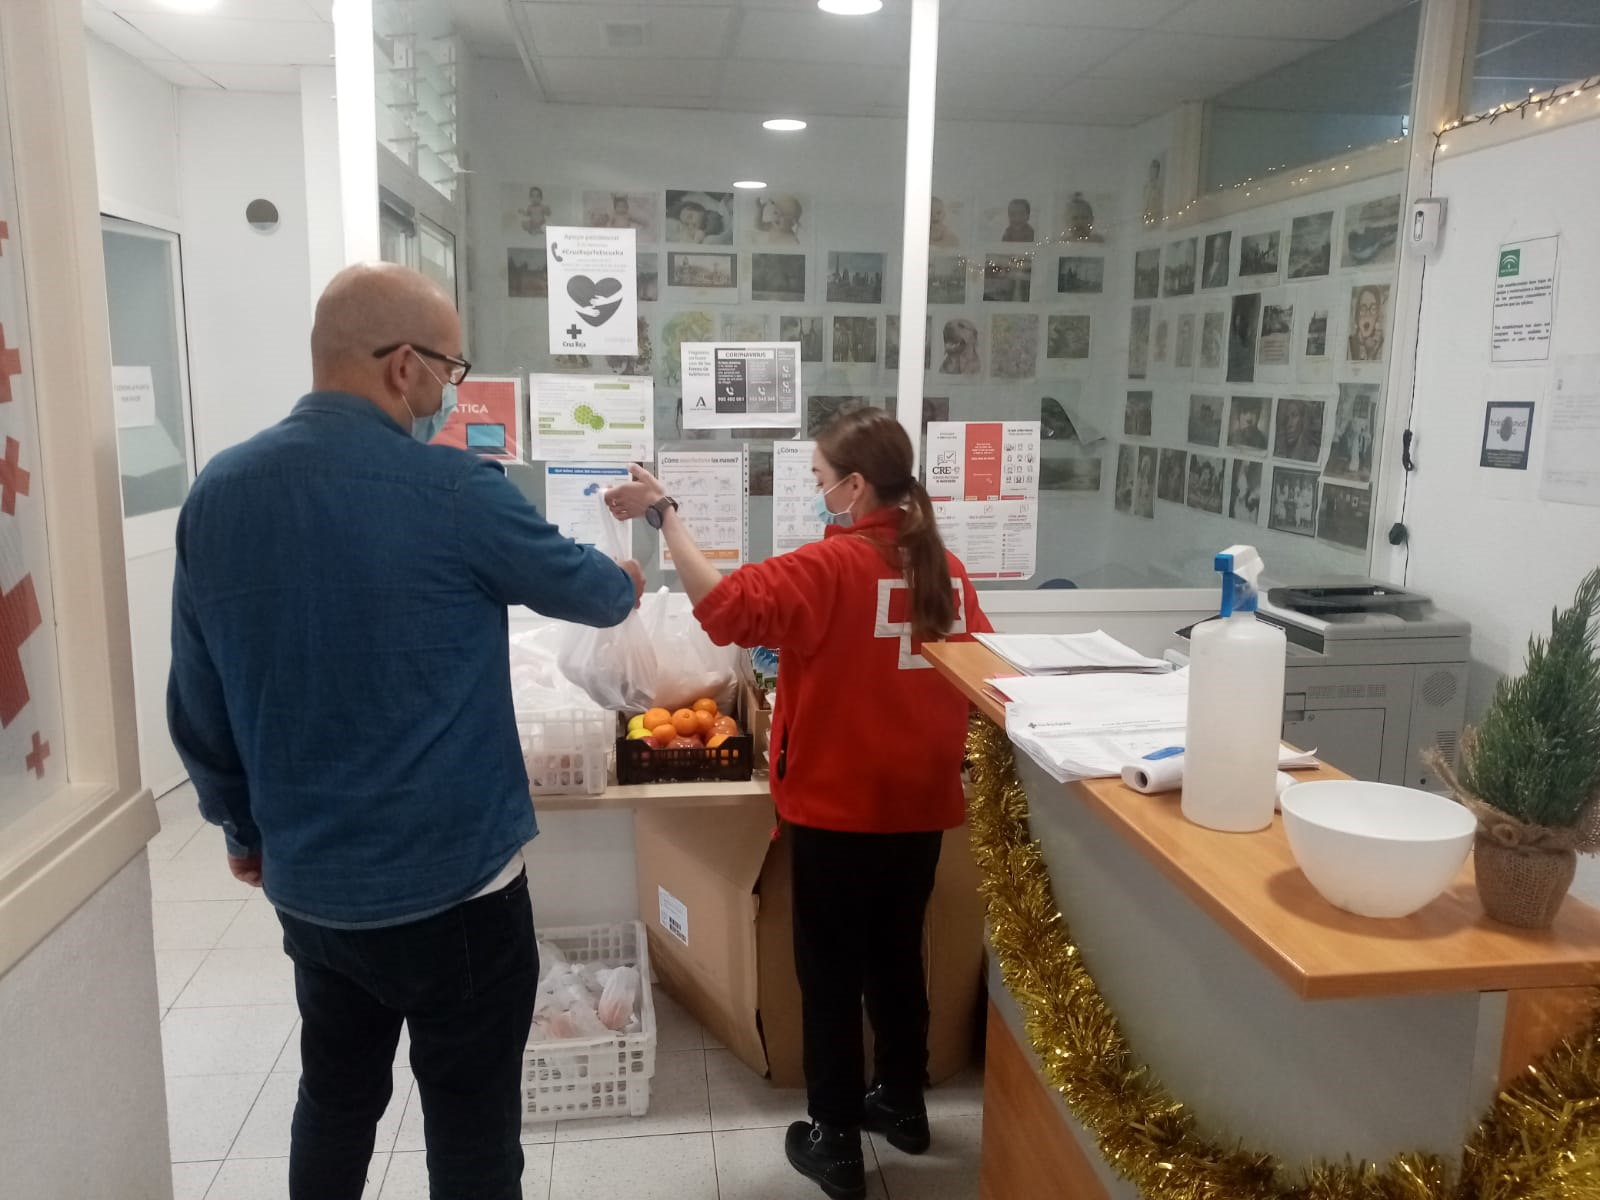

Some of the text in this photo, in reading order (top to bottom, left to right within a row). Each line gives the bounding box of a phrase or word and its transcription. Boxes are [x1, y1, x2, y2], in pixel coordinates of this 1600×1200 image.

[575, 340, 586, 349] Roja
[777, 446, 799, 455] ¿Cómo
[661, 456, 679, 465] ¿Cómo
